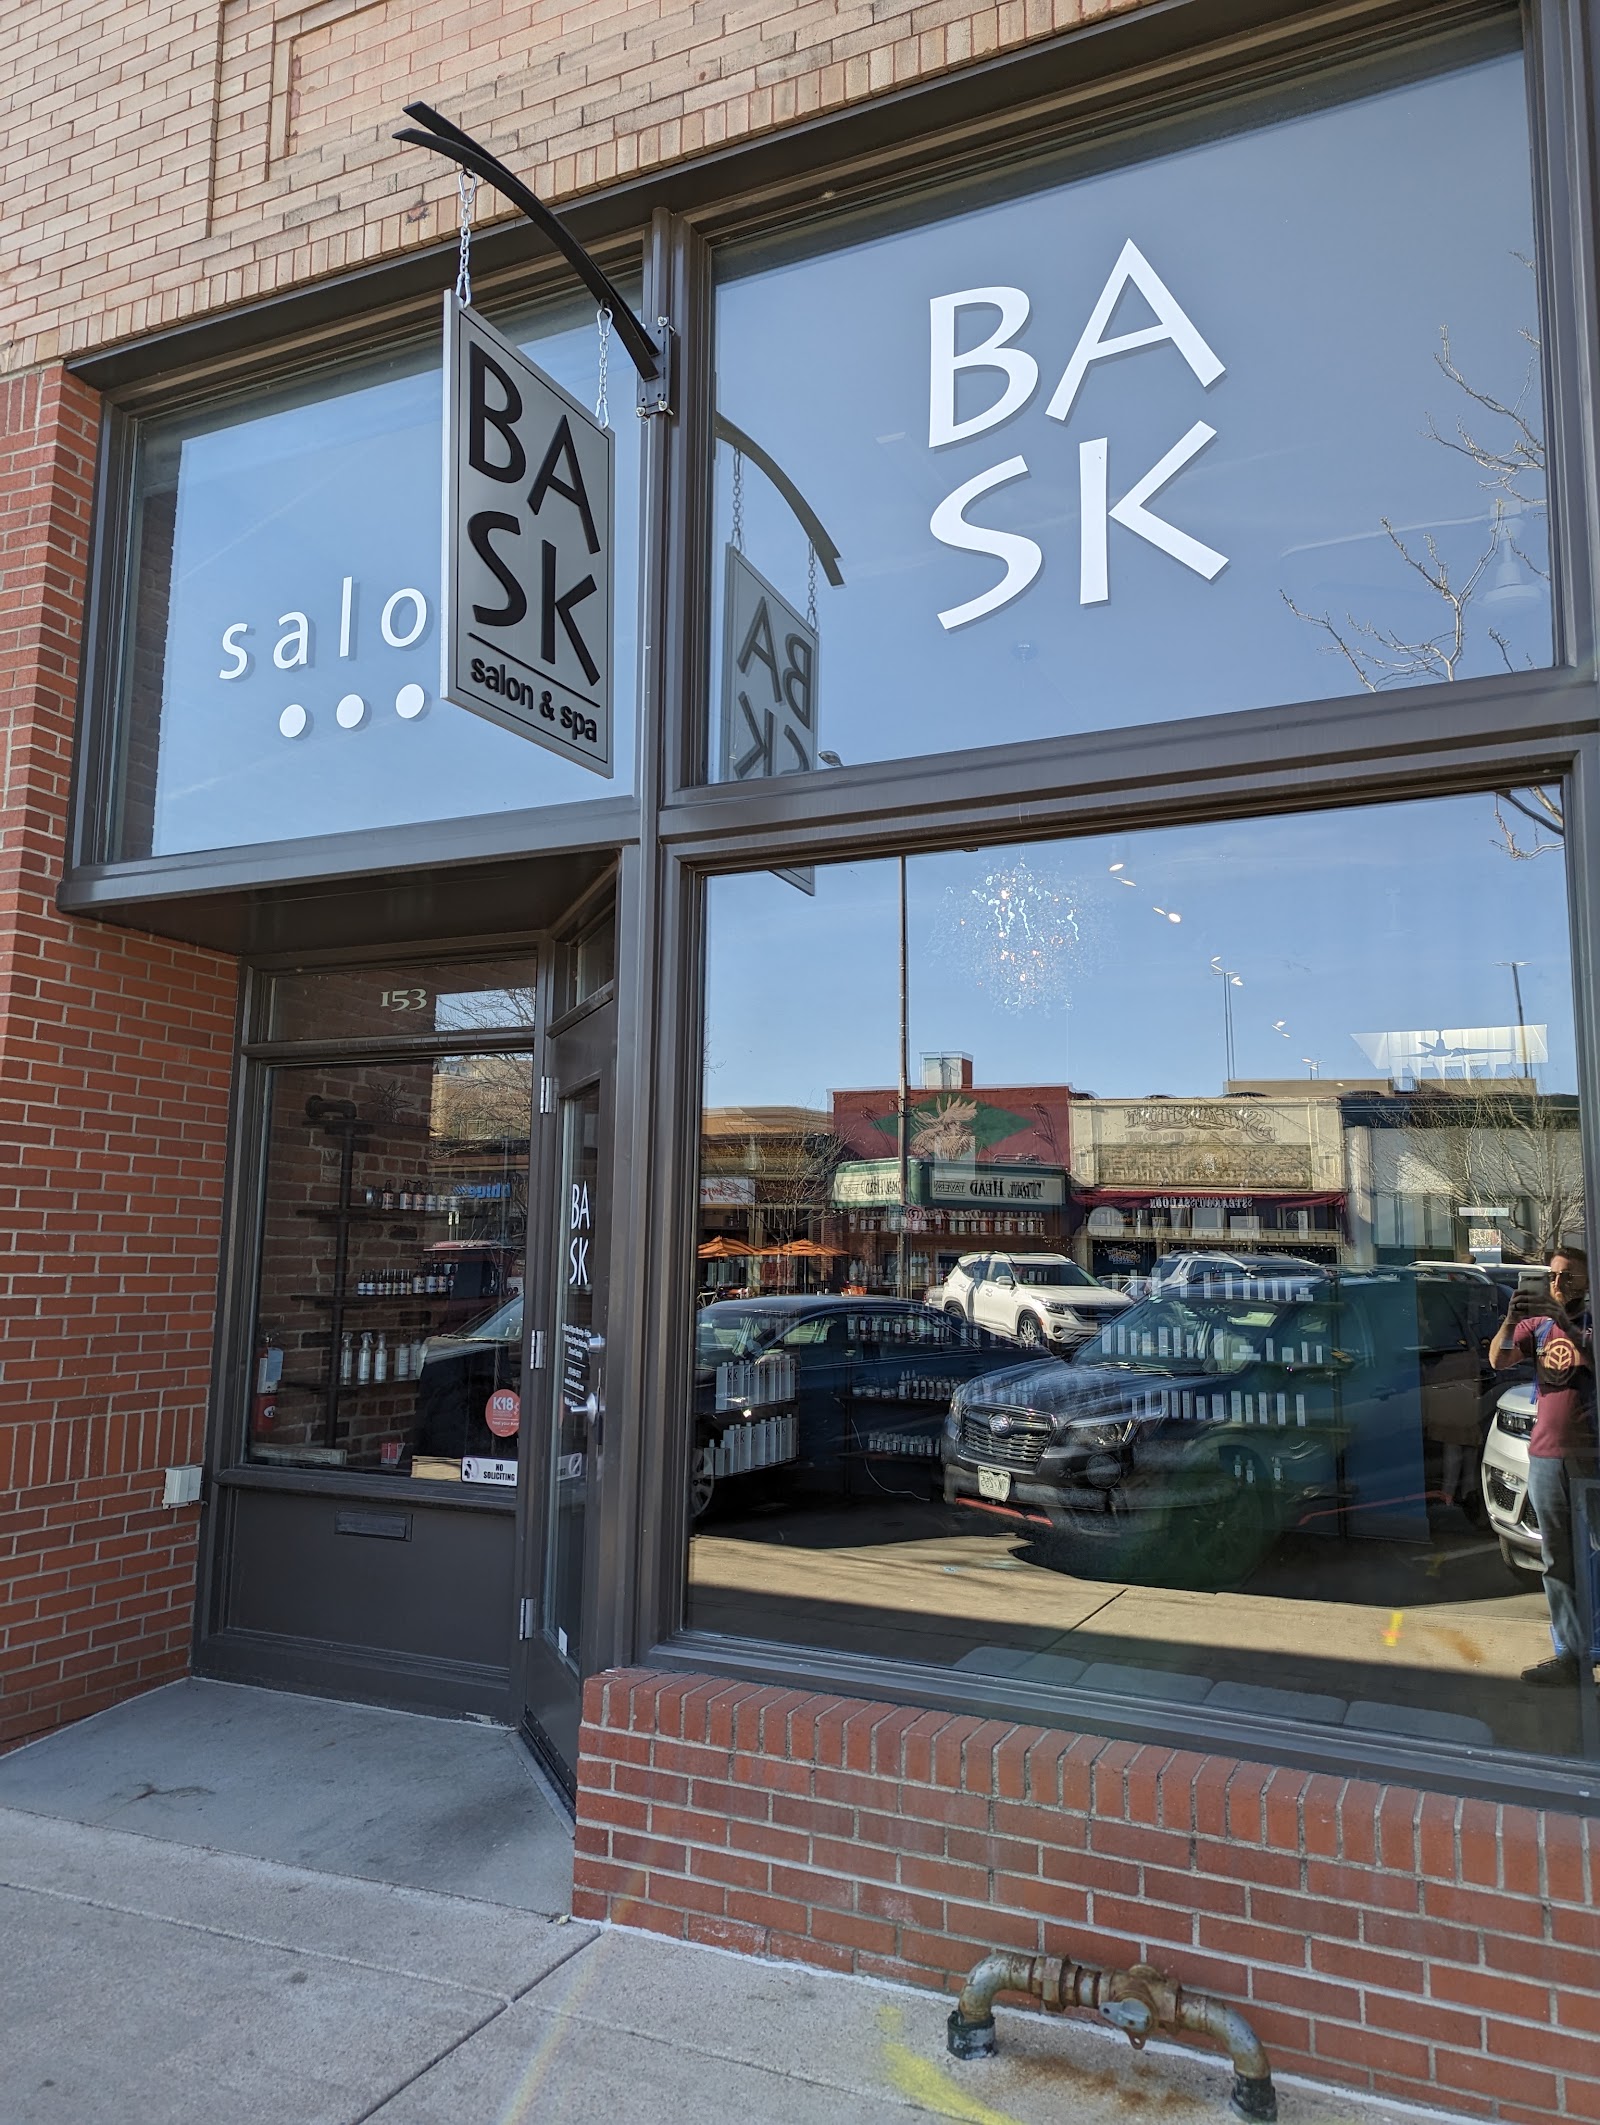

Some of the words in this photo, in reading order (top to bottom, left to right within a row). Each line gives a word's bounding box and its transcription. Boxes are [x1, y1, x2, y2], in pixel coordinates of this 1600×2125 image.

[219, 576, 428, 681] salo
[470, 657, 534, 710] salon
[539, 690, 556, 721] &
[560, 705, 598, 743] spa
[380, 988, 428, 1012] 153
[492, 1396, 514, 1411] K18
[483, 1471, 516, 1482] SOLICITING
[495, 1463, 504, 1472] NO
